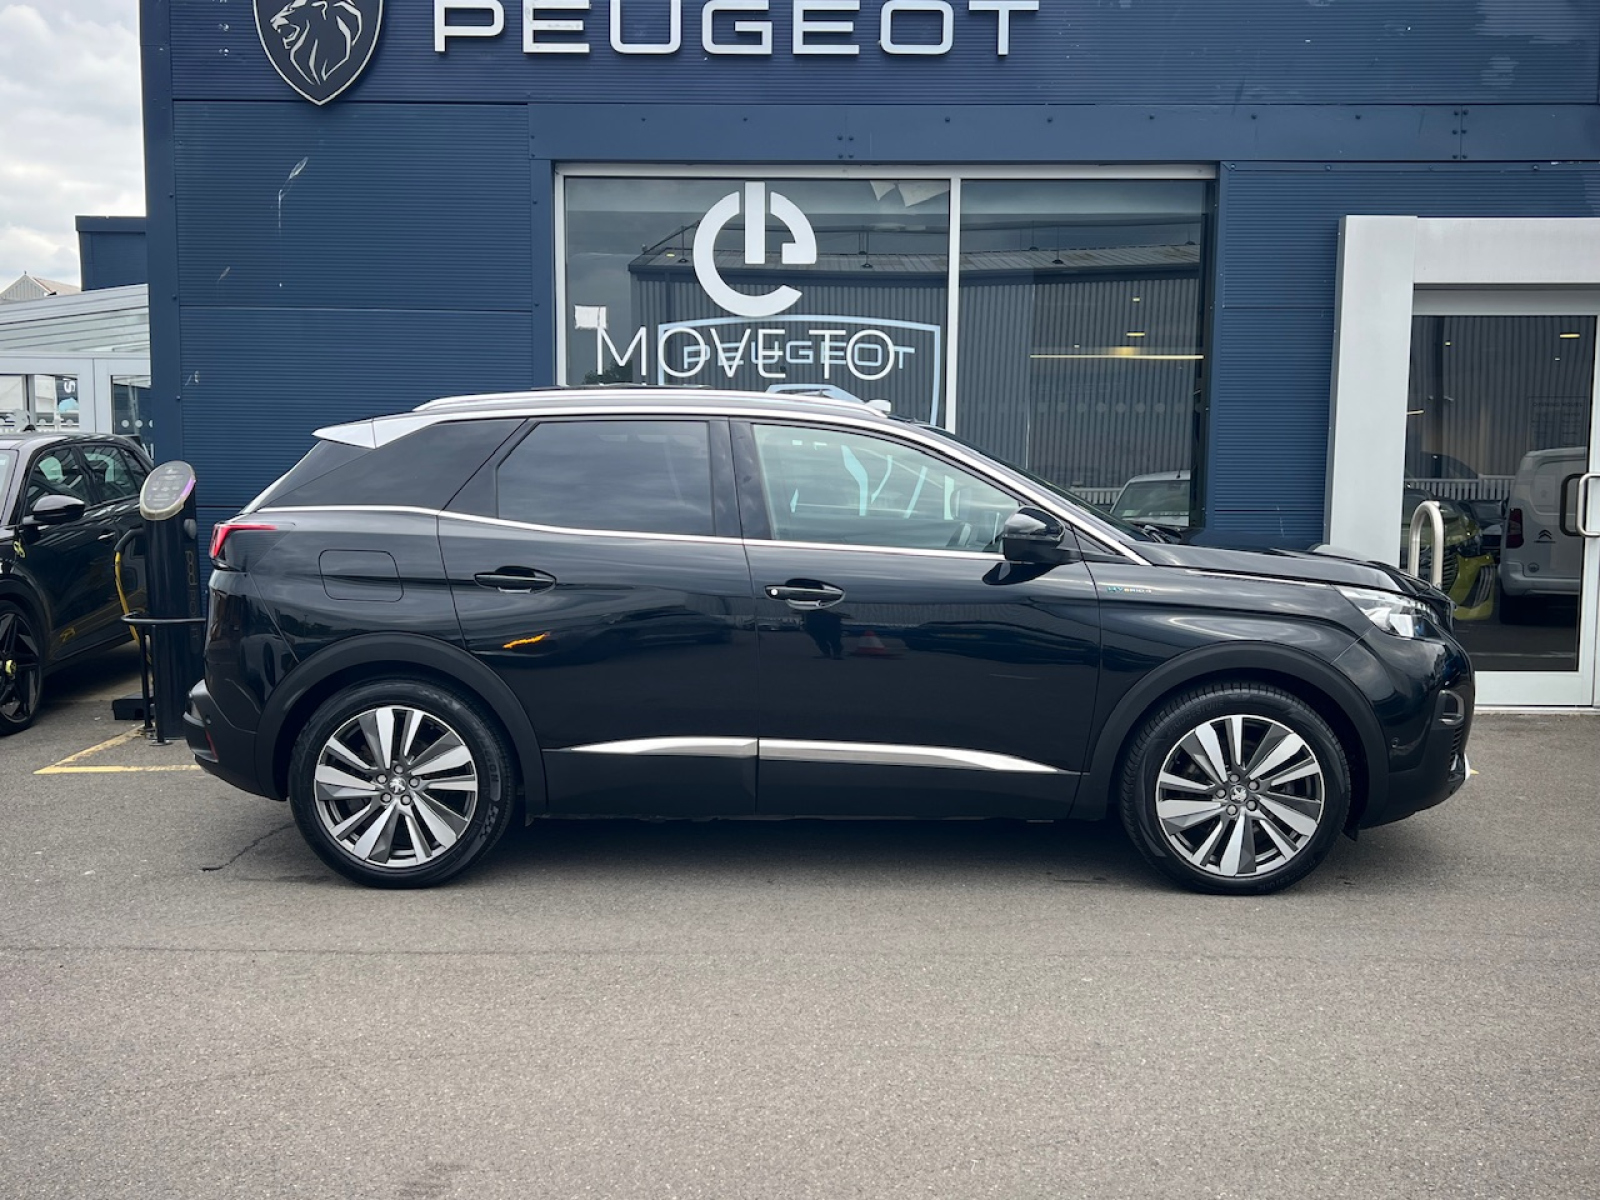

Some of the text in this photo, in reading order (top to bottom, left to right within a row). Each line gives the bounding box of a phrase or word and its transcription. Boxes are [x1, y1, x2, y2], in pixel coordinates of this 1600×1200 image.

[435, 0, 1040, 55] PEUGEOT
[597, 326, 896, 380] MOVE TO
[683, 340, 916, 369] PEUGEOT
